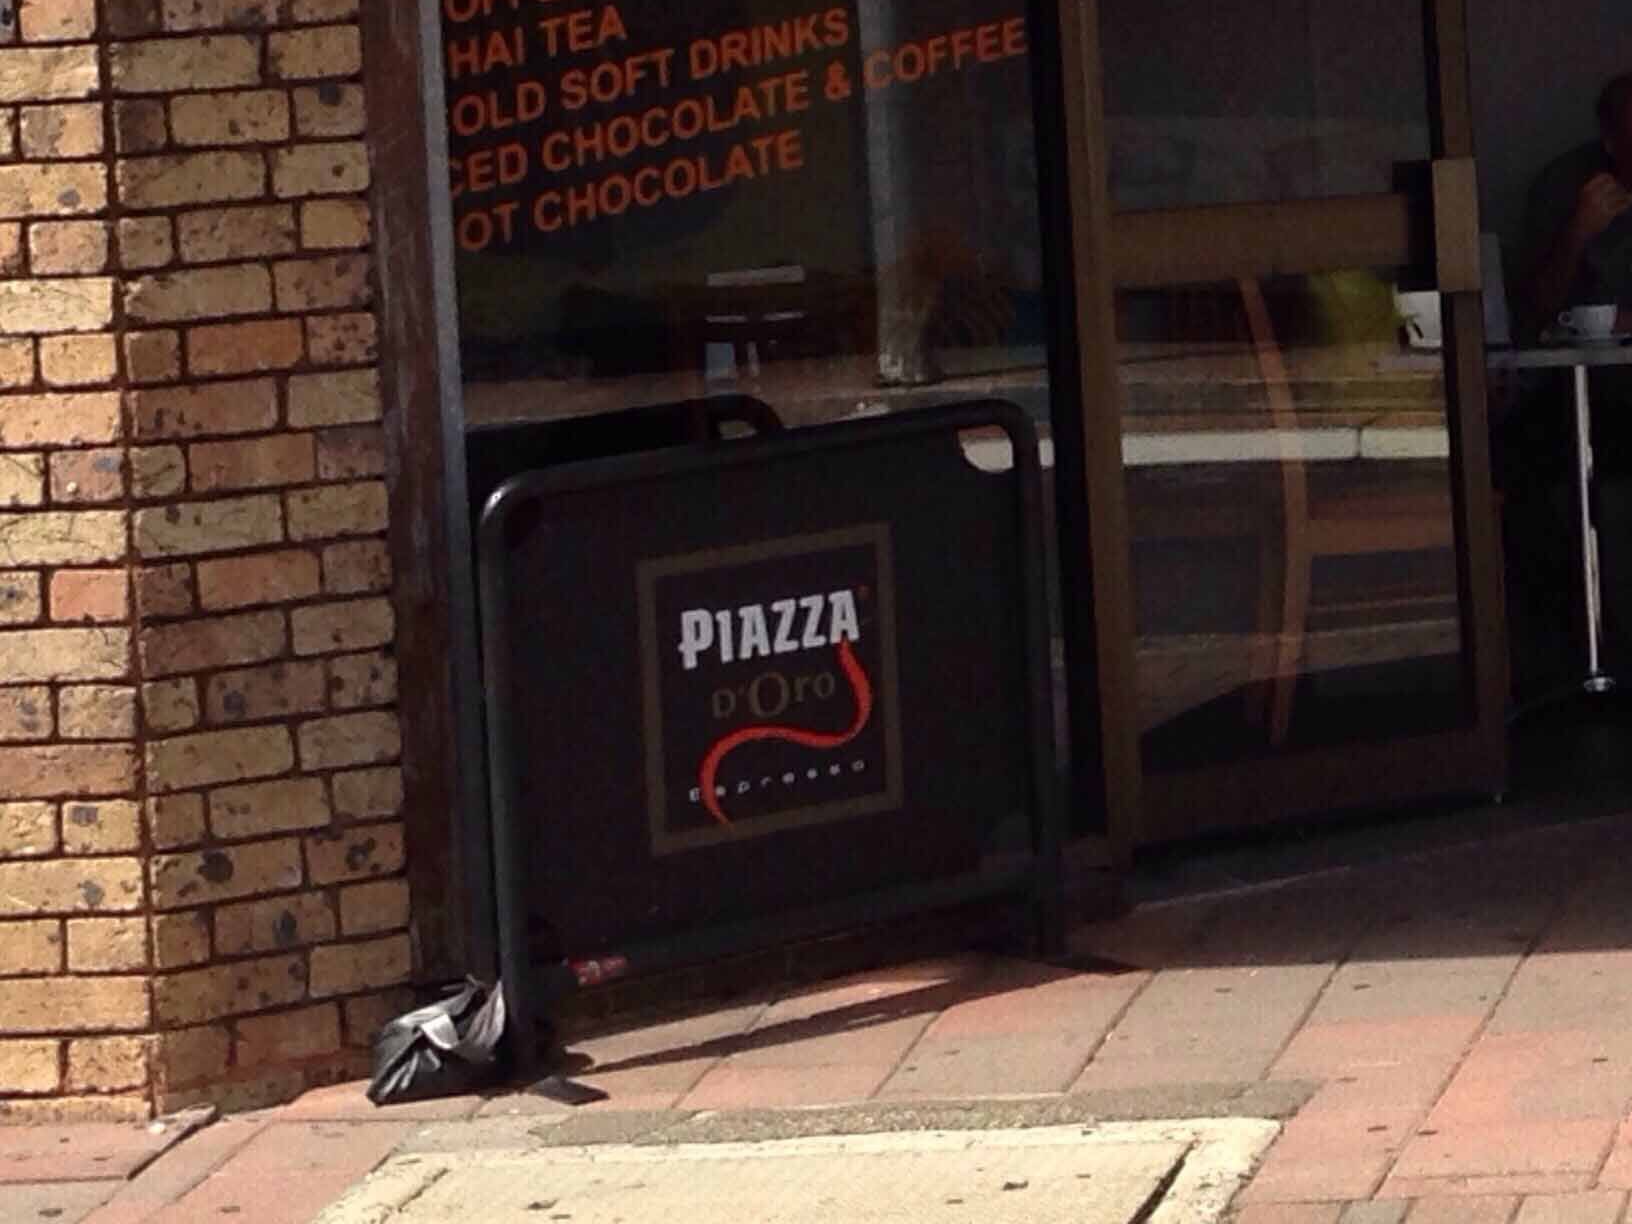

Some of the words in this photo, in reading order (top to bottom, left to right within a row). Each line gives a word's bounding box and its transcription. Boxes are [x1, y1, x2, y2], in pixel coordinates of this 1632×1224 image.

[541, 4, 628, 57] TEA
[561, 49, 674, 111] SOFT
[690, 7, 849, 79] DRINKS
[542, 69, 809, 173] CHOCOLATE
[825, 61, 851, 101] &
[864, 17, 1029, 90] COFFEE
[532, 130, 802, 232] CHOCOLATE
[677, 589, 861, 671] PIAZZA
